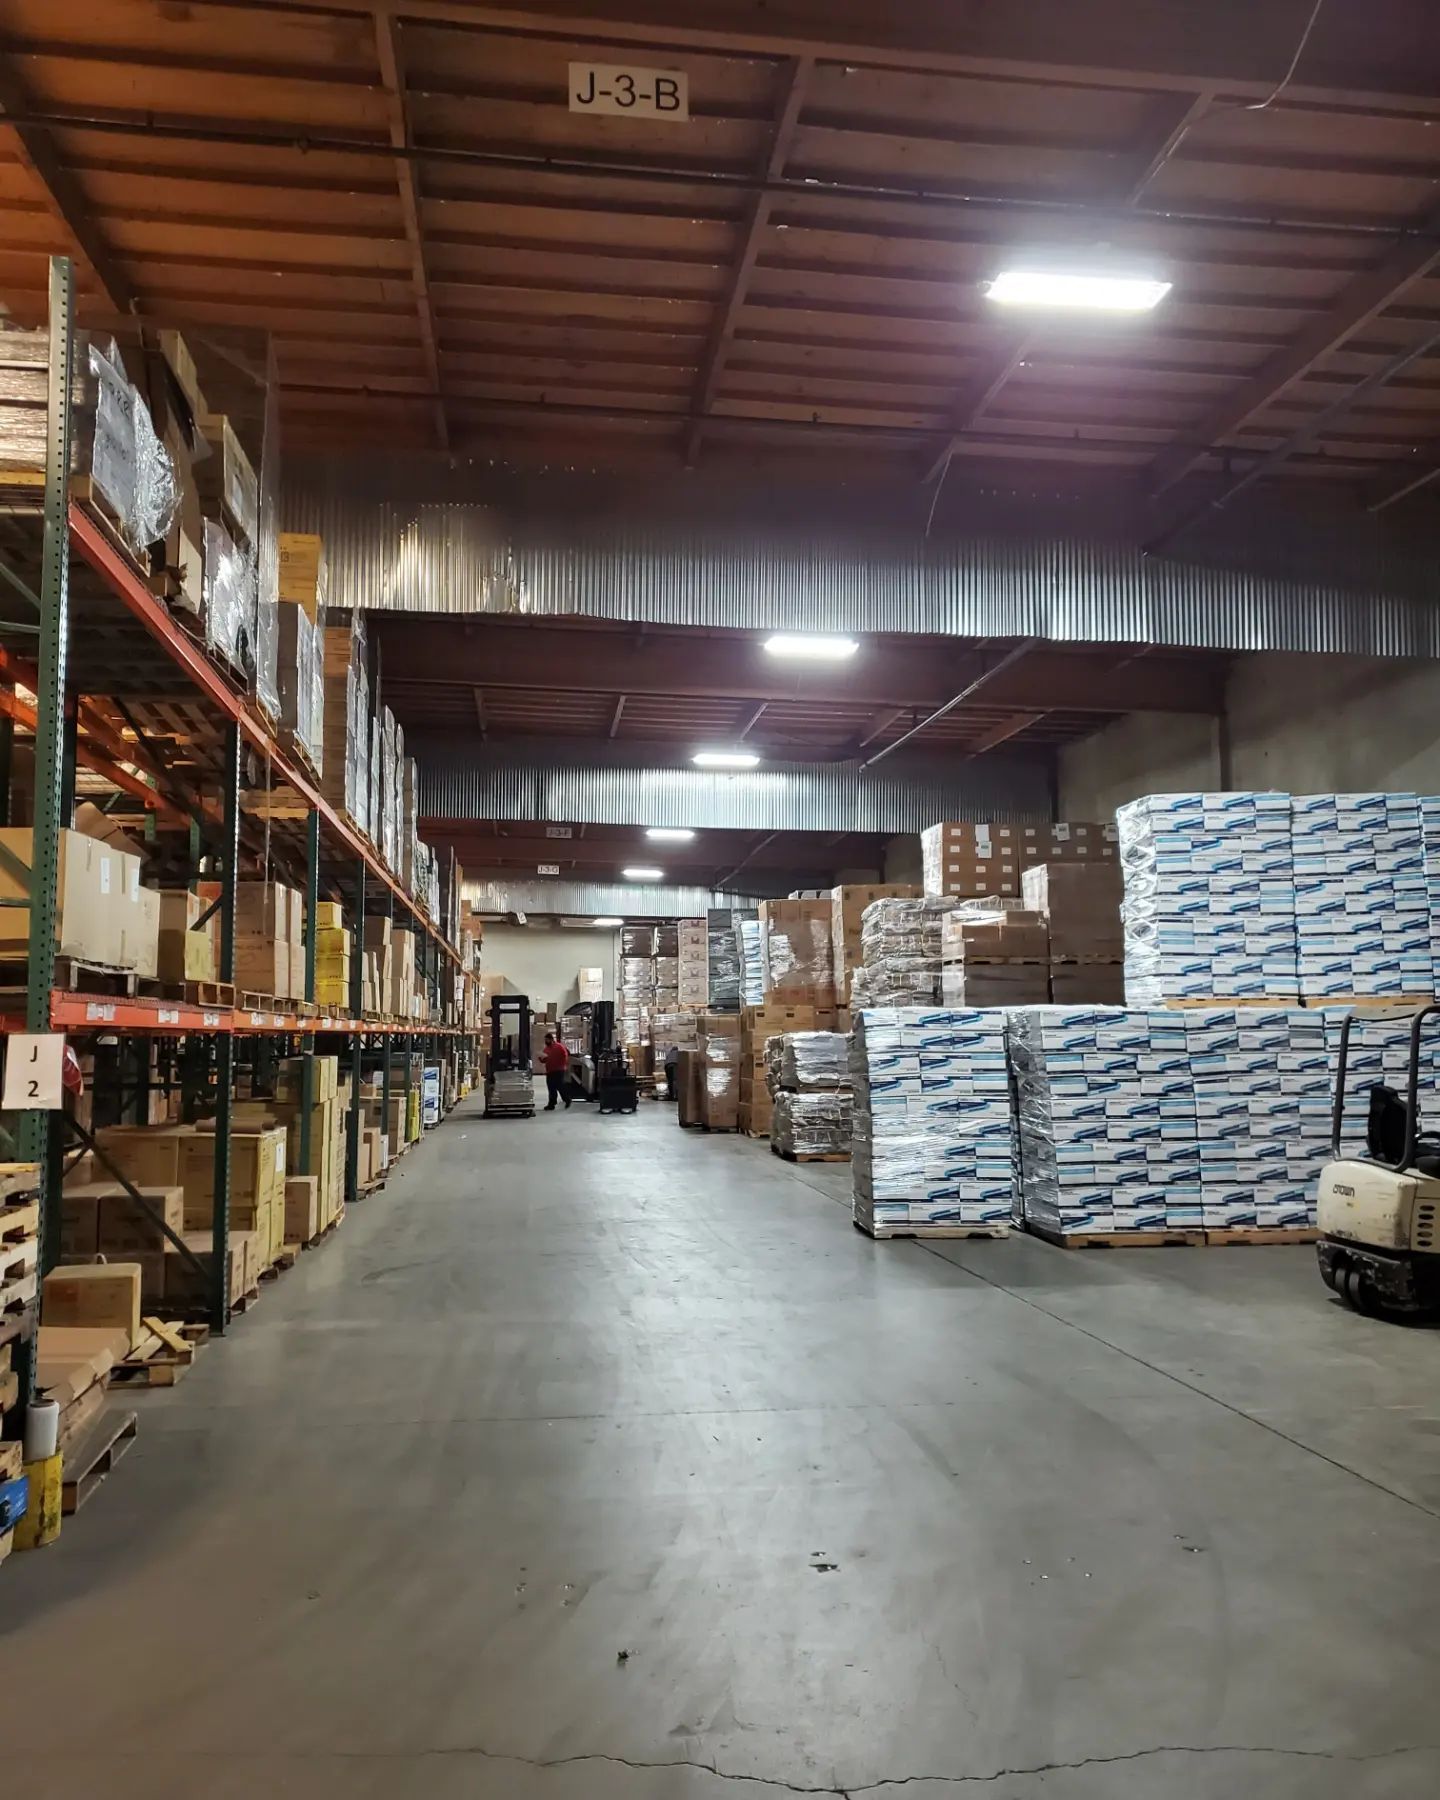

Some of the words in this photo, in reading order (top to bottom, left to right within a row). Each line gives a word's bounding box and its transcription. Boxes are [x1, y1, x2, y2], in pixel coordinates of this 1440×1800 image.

[576, 71, 680, 111] J-3-B
[30, 1045, 38, 1063] J
[28, 1080, 39, 1097] 2
